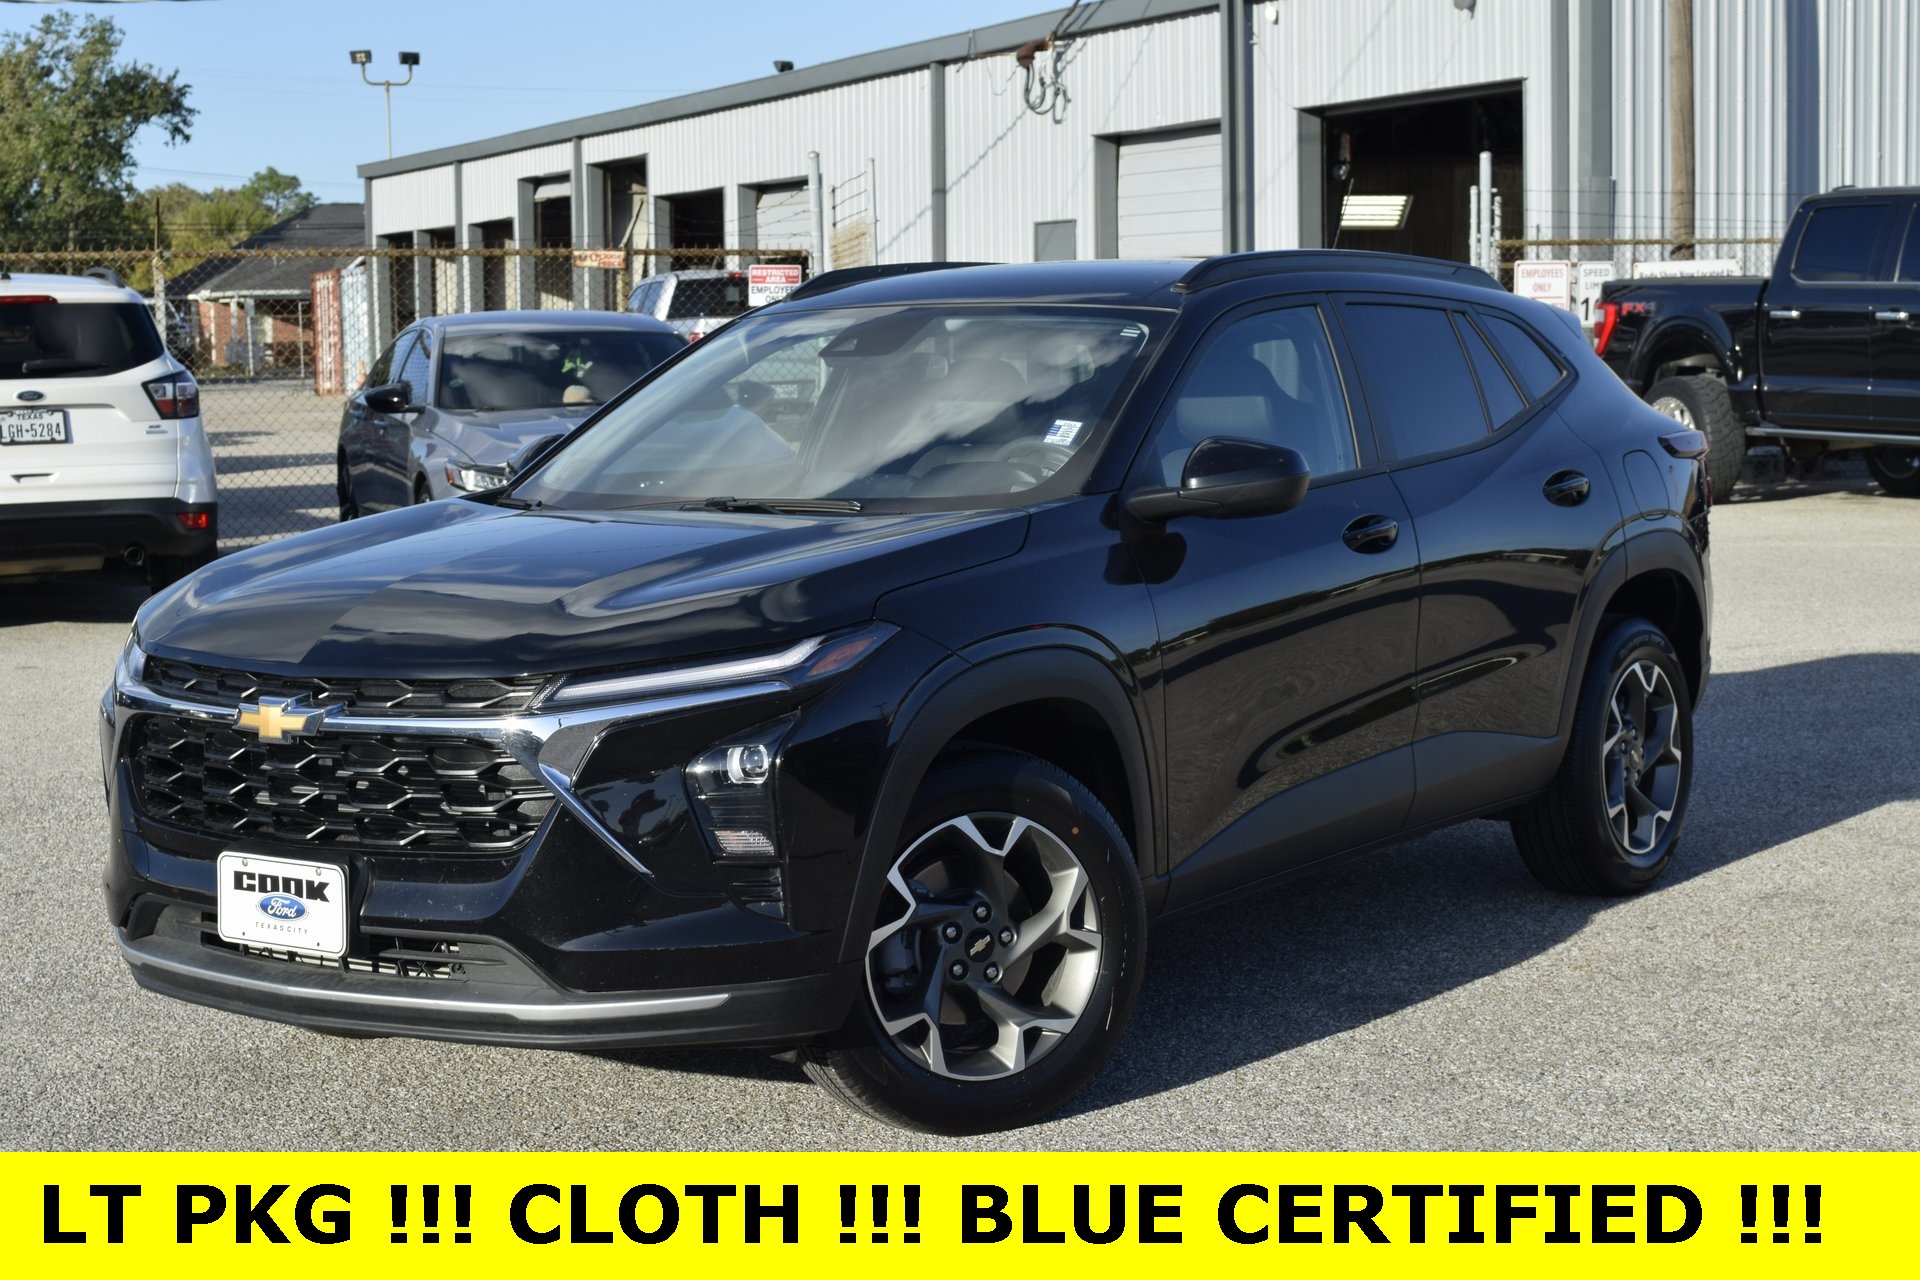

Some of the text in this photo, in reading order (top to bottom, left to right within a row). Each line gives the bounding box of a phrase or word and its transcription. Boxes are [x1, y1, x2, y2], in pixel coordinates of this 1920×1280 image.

[1521, 268, 1564, 278] EMPLOYEES
[1583, 268, 1610, 277] SPEED
[1532, 282, 1552, 292] ONLY
[1585, 281, 1601, 290] LIM
[1621, 302, 1656, 316] FX4
[233, 870, 330, 903] COOK
[267, 897, 298, 917] Ford
